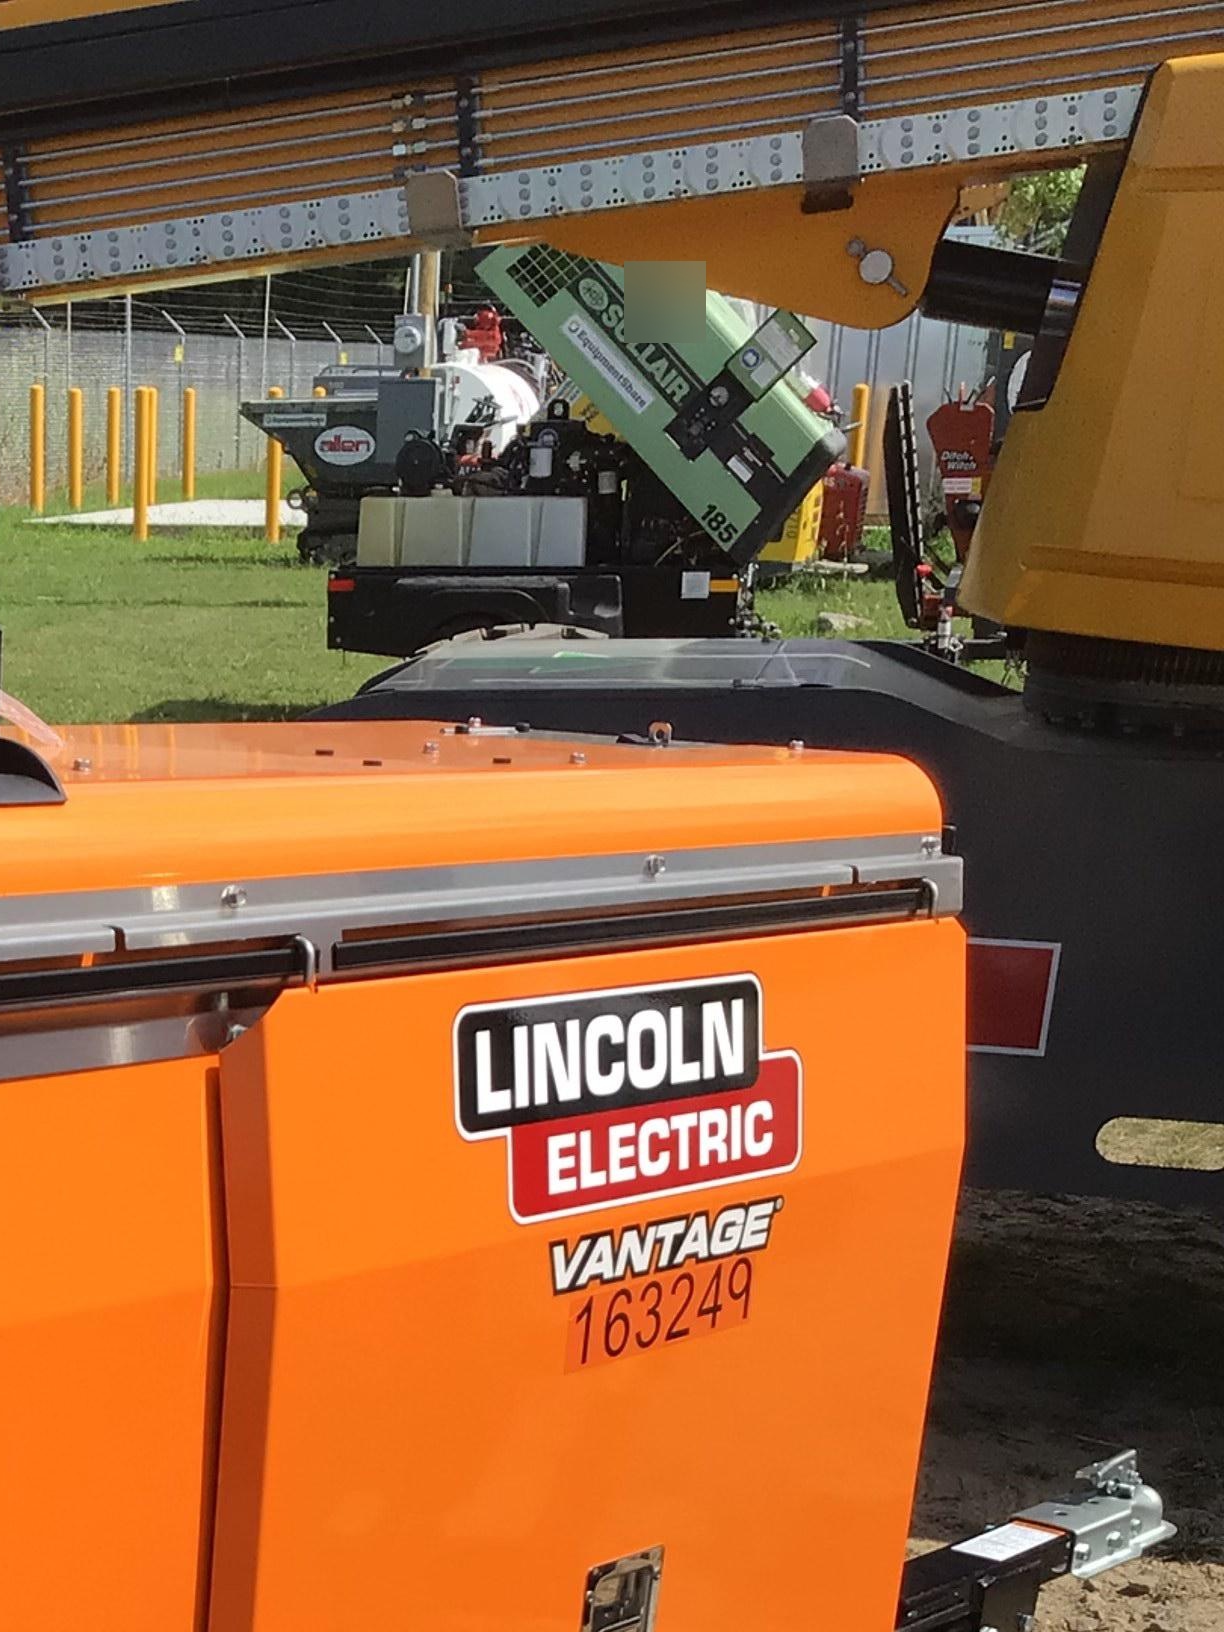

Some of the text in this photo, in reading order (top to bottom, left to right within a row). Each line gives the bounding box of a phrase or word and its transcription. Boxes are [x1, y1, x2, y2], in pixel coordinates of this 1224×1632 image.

[577, 330, 647, 409] EquipmentShare
[320, 434, 371, 452] allen
[941, 450, 970, 461] Ditch
[947, 460, 977, 471] Witch
[699, 502, 739, 543] 185
[475, 997, 745, 1116] LINCOLN
[546, 1099, 774, 1196] ELECTRIC
[576, 1257, 754, 1365] 163249
